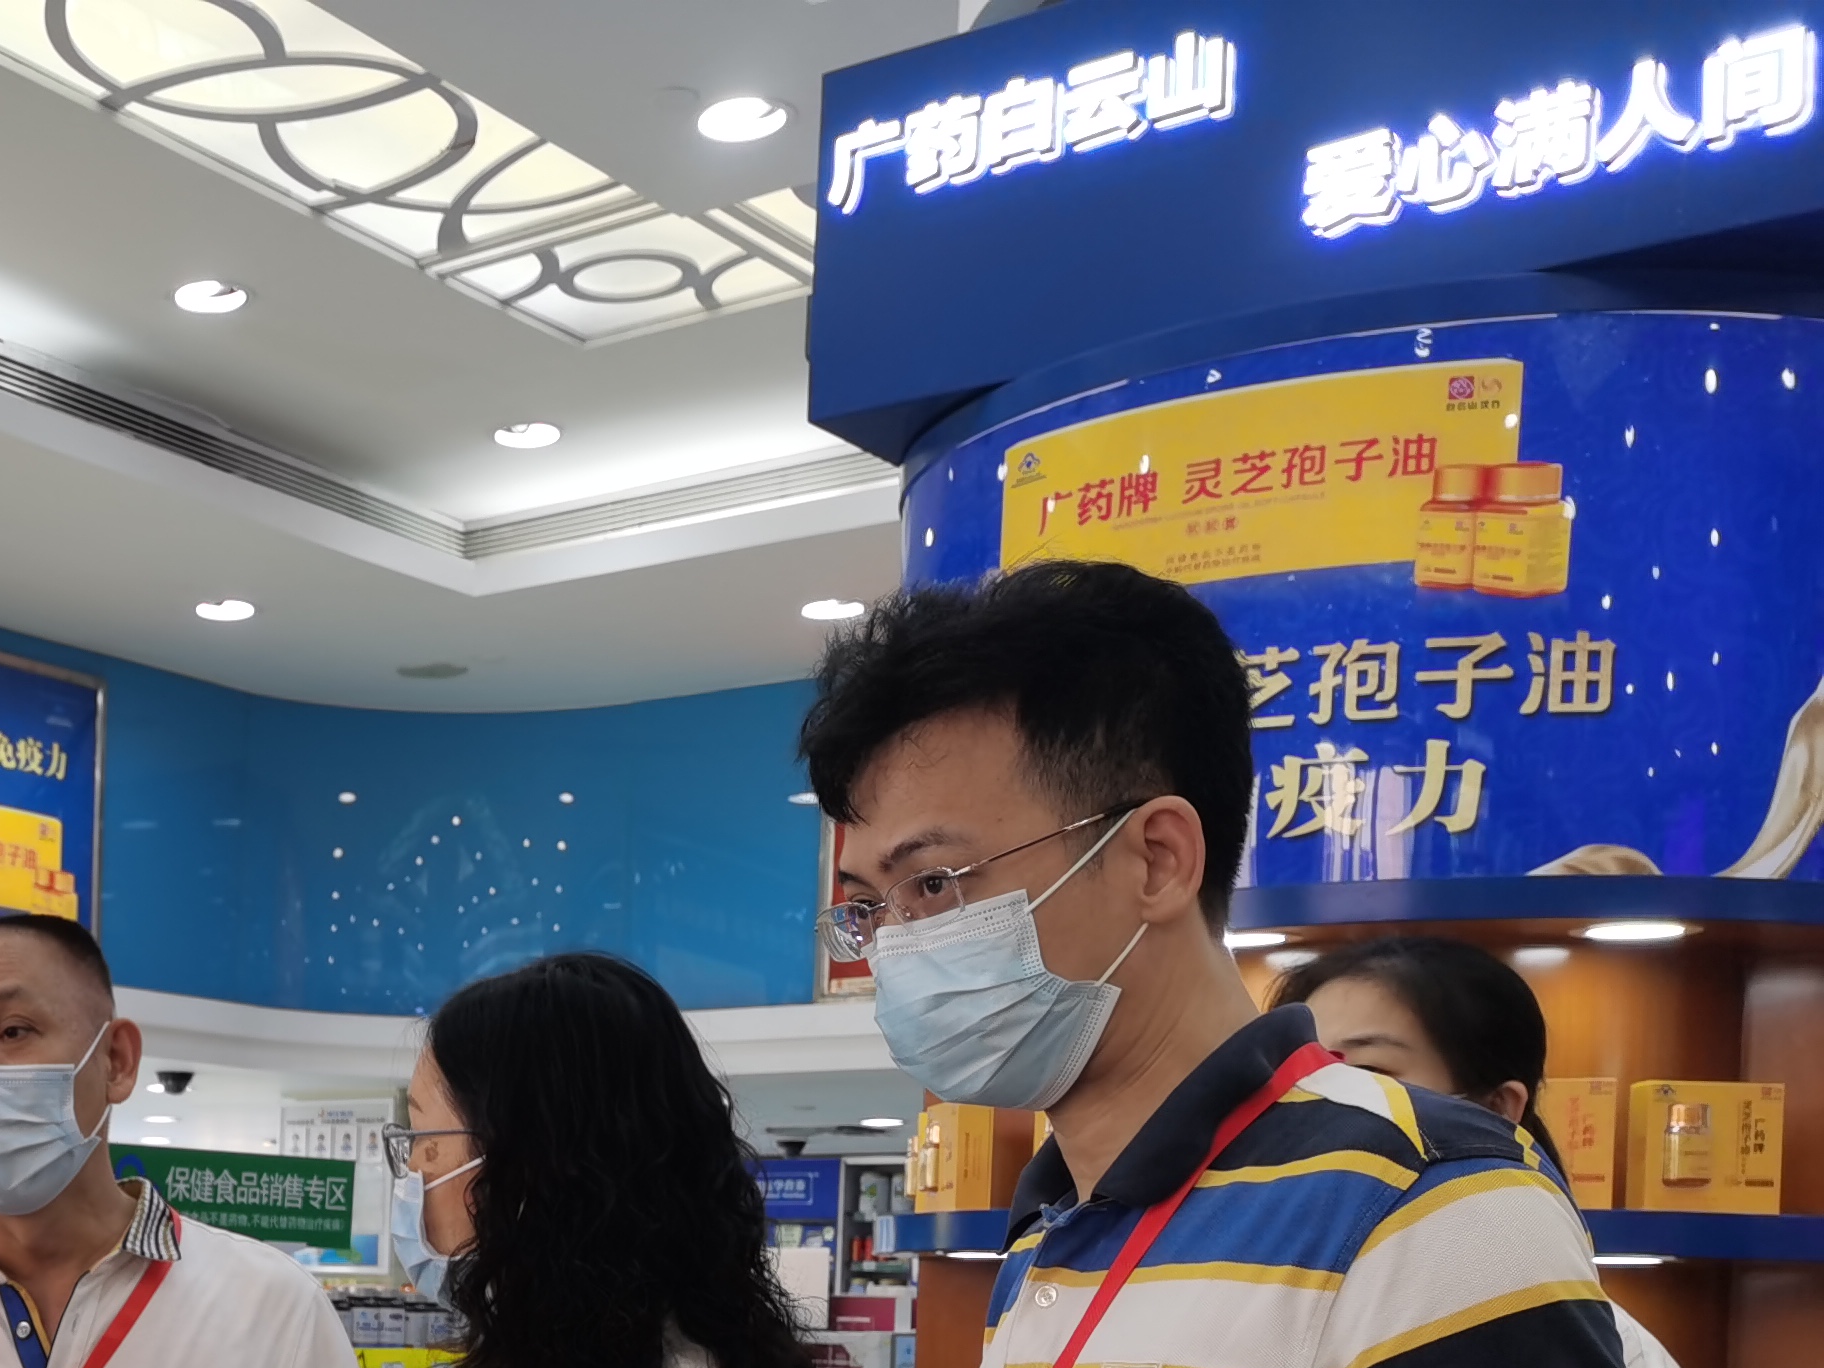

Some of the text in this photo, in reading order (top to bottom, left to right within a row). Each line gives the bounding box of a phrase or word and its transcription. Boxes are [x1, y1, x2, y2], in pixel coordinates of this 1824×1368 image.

[829, 30, 1237, 215] 广药白云山
[1300, 22, 1819, 240] 爱心满人间
[1038, 471, 1159, 537] 广药牌
[1181, 433, 1439, 505] 灵芝孢子油
[1265, 739, 1490, 839] 疫力
[165, 1165, 348, 1212] 保健食品销售专区
